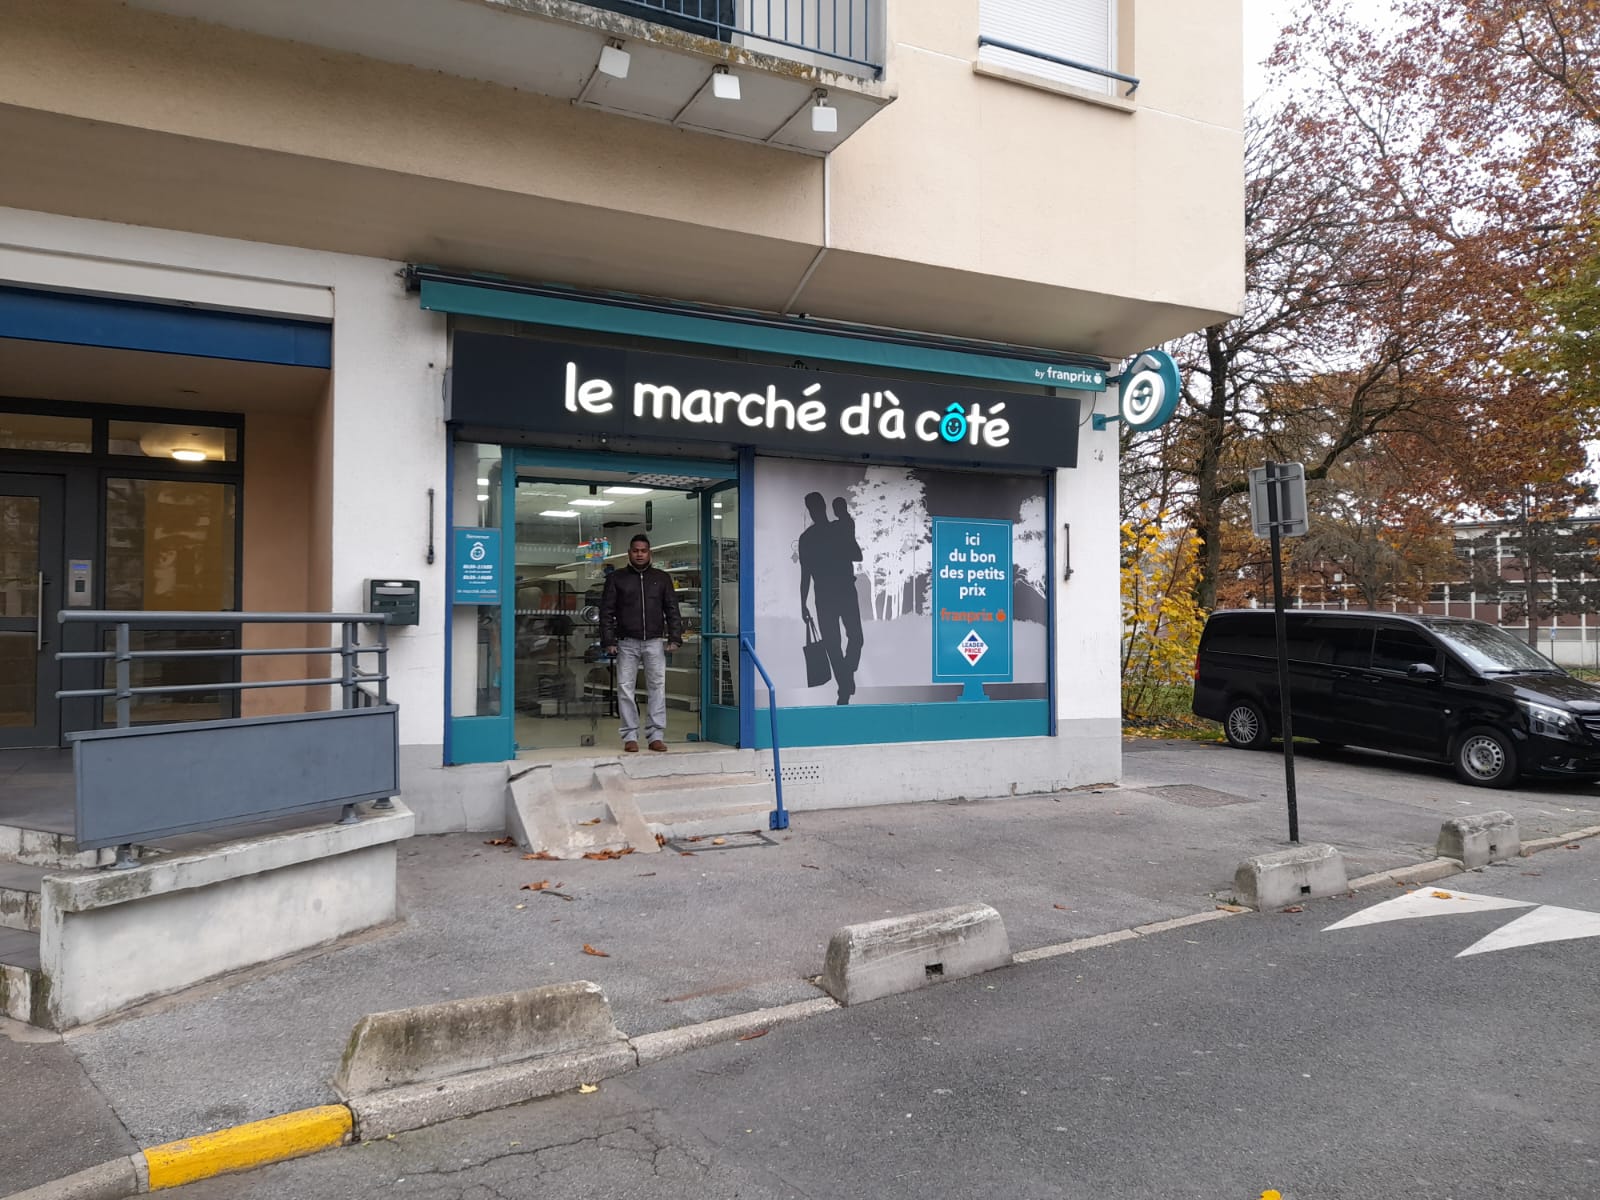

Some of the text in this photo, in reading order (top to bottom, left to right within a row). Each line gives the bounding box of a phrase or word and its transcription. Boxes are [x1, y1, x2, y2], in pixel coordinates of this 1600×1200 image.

[1034, 367, 1092, 383] by franprix
[565, 361, 1010, 447] le marché d'à côté
[966, 532, 980, 546] ici
[949, 548, 996, 563] du bon
[939, 565, 1005, 583] des petits
[959, 584, 986, 599] prix
[940, 608, 993, 624] franprix
